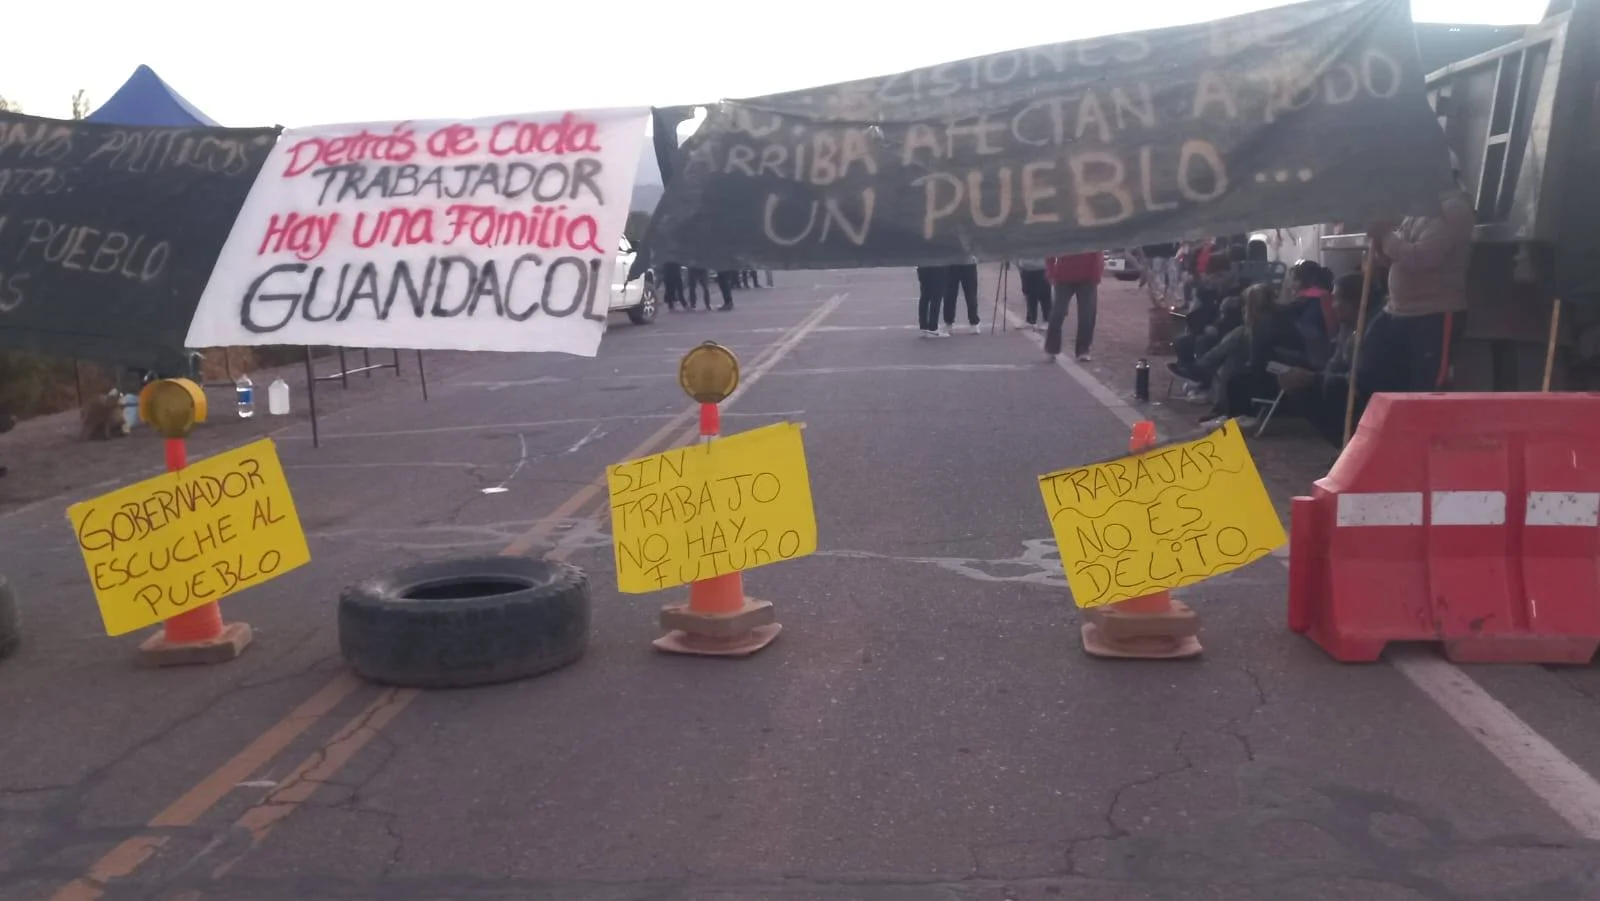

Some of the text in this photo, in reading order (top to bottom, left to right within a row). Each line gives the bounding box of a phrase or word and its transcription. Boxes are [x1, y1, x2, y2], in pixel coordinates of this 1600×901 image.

[282, 112, 602, 178] Detrás de Cada
[901, 82, 1157, 167] AFECTAN
[1193, 70, 1238, 119] A
[312, 158, 604, 206] TRABAJADOR
[257, 211, 340, 261] Hay
[442, 204, 606, 254] Familia
[764, 187, 876, 246] UN
[16, 217, 170, 282] PUEBLO
[239, 253, 606, 334] GUANDACOL
[78, 458, 265, 552] GOBERNADOR
[612, 450, 685, 496] SIN
[612, 472, 781, 532] TRABAJO
[1039, 440, 1224, 506] TRABAJAR
[94, 496, 286, 591] ESCUCHE AL
[618, 516, 747, 573] NO HAY
[643, 528, 800, 588] FUTURO
[1076, 493, 1203, 559] NO ES
[133, 549, 281, 616] PUEBLO
